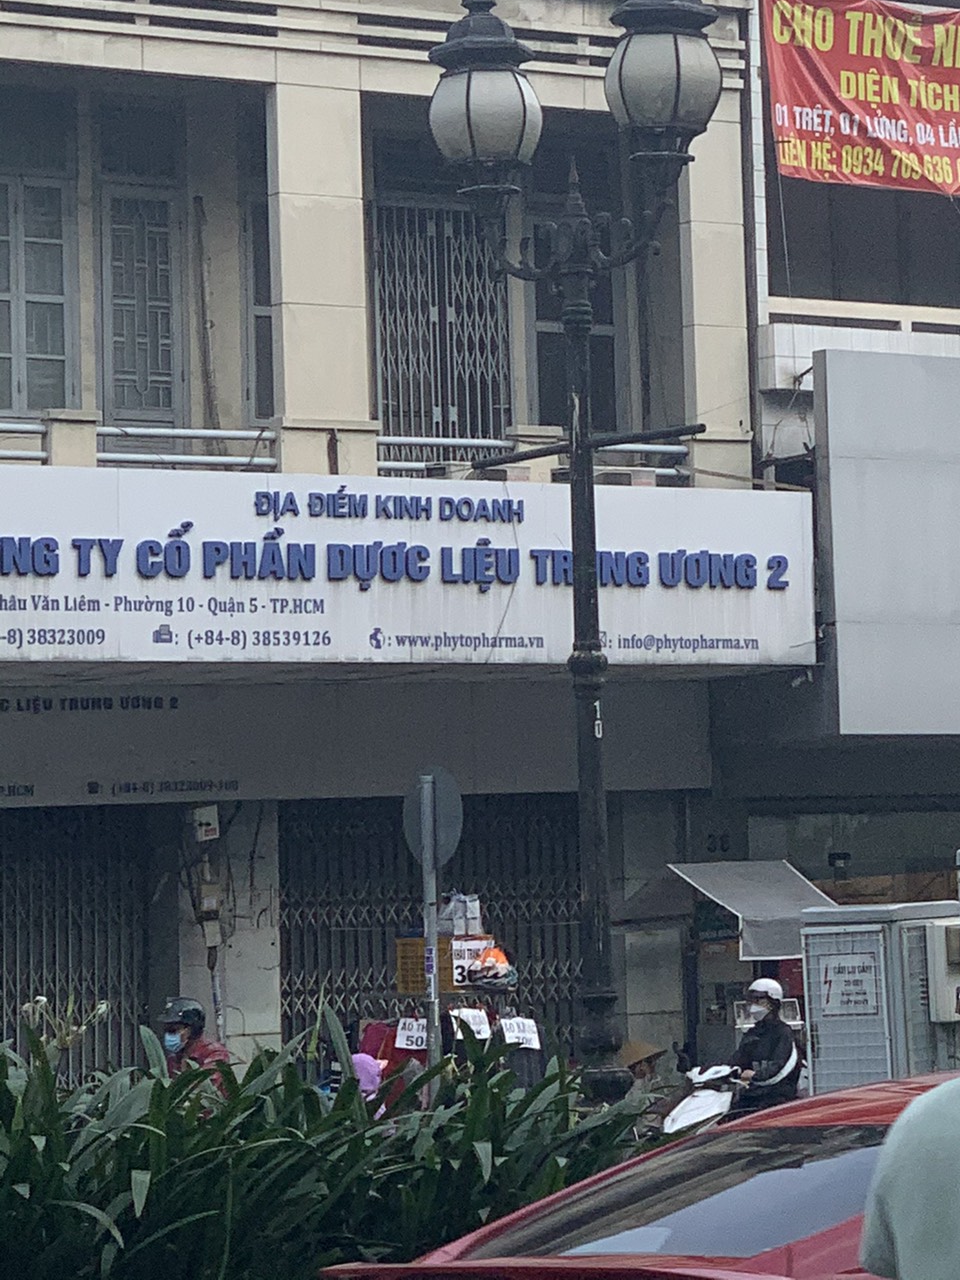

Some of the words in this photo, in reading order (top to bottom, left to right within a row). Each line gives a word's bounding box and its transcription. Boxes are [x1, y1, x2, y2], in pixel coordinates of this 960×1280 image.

[773, 0, 834, 52] CHO
[845, 10, 923, 64] THUÊ
[840, 68, 900, 109] DIỆN
[775, 103, 789, 127] 01
[793, 104, 835, 137] TRỆT,
[916, 119, 935, 147] 04
[779, 132, 806, 169] LIÊN
[841, 145, 885, 177] 0934
[923, 154, 953, 185] 636
[254, 491, 299, 522] ĐỊA
[307, 485, 369, 520] ĐIỂM
[375, 495, 432, 521] KINH
[438, 496, 524, 523] DOANH
[71, 538, 124, 577] TY
[136, 521, 194, 579] CỔ
[202, 527, 316, 581] PHẦN
[441, 537, 520, 593] LIỆU
[530, 549, 650, 587] TRNG
[658, 549, 758, 589] ƯƠNG
[766, 555, 789, 590] 2
[31, 595, 60, 612] Văn
[64, 594, 100, 612] Liêm
[113, 595, 173, 617] Phường
[177, 597, 195, 612] 10
[208, 596, 245, 617] Quận
[250, 597, 258, 613] 5
[270, 598, 325, 614] TP.HCM
[27, 628, 105, 645] 38323009
[188, 630, 247, 650] (+84-8)
[252, 630, 331, 646] 38539126
[395, 631, 544, 651] www.phytopharma.vn
[618, 634, 759, 653] info@phytopharma.vn
